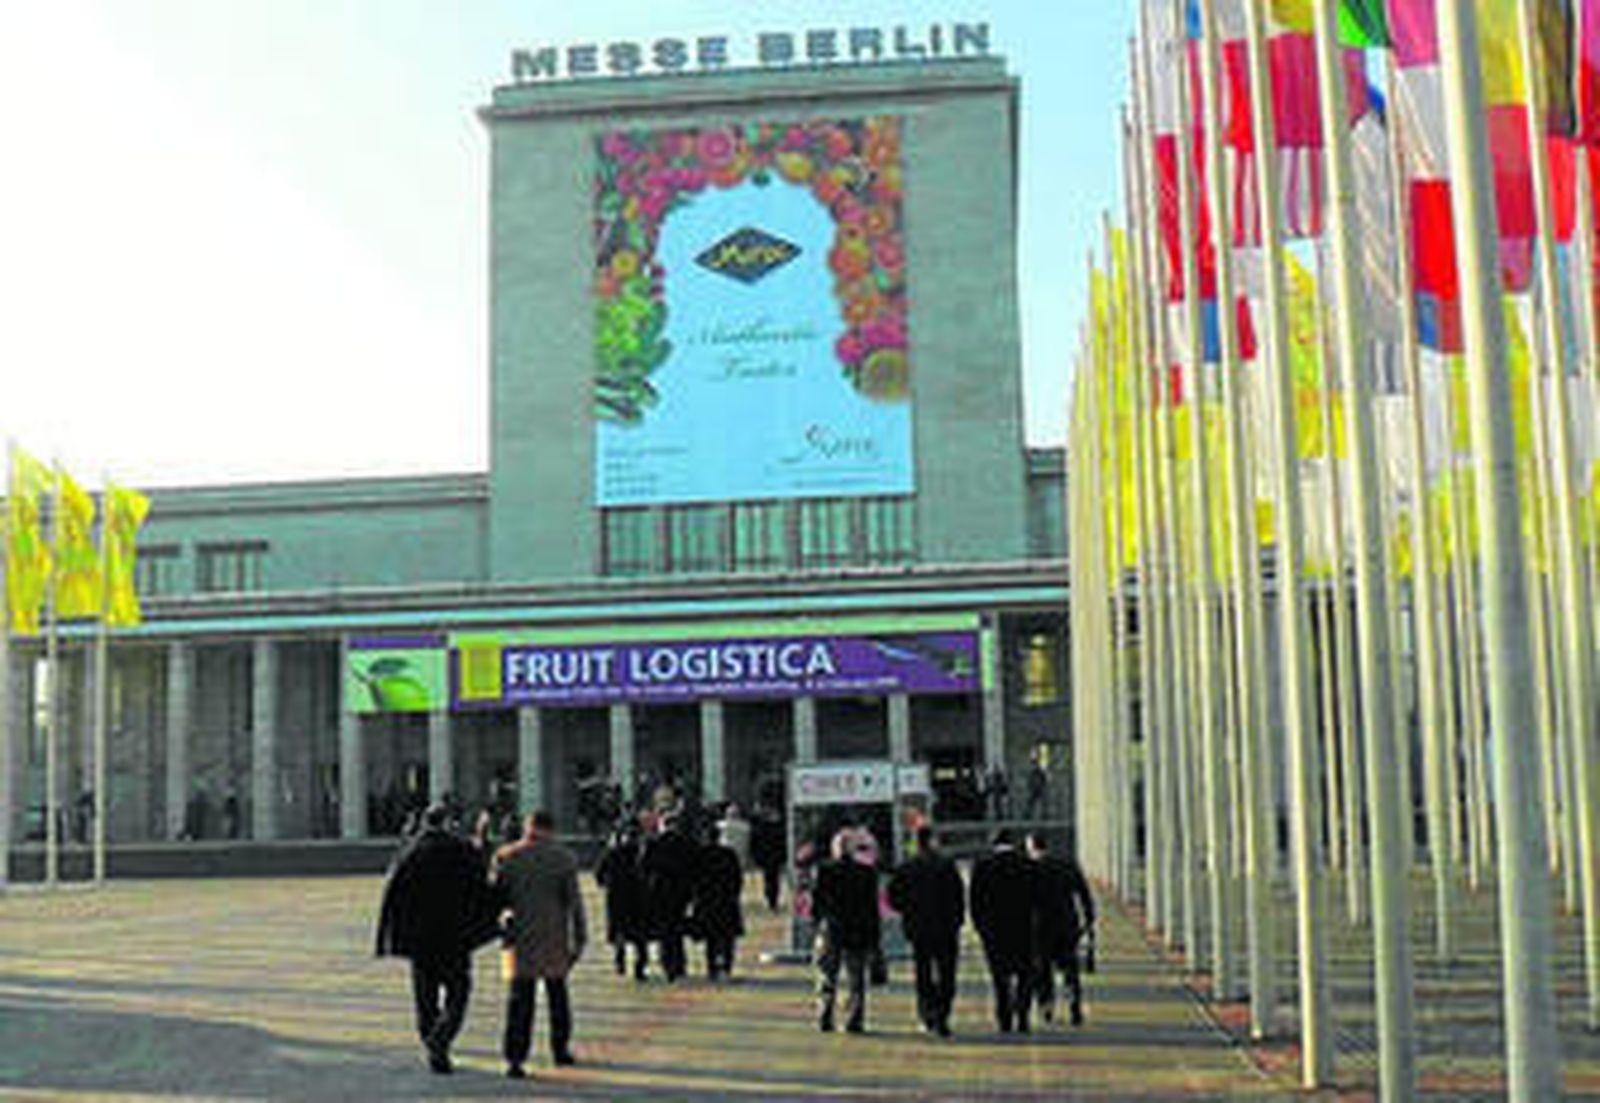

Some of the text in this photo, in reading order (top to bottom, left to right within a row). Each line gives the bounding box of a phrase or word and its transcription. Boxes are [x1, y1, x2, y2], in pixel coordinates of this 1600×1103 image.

[511, 22, 991, 78] MESSE BERLIN
[505, 643, 836, 685] FRUIT LOGISTICA
